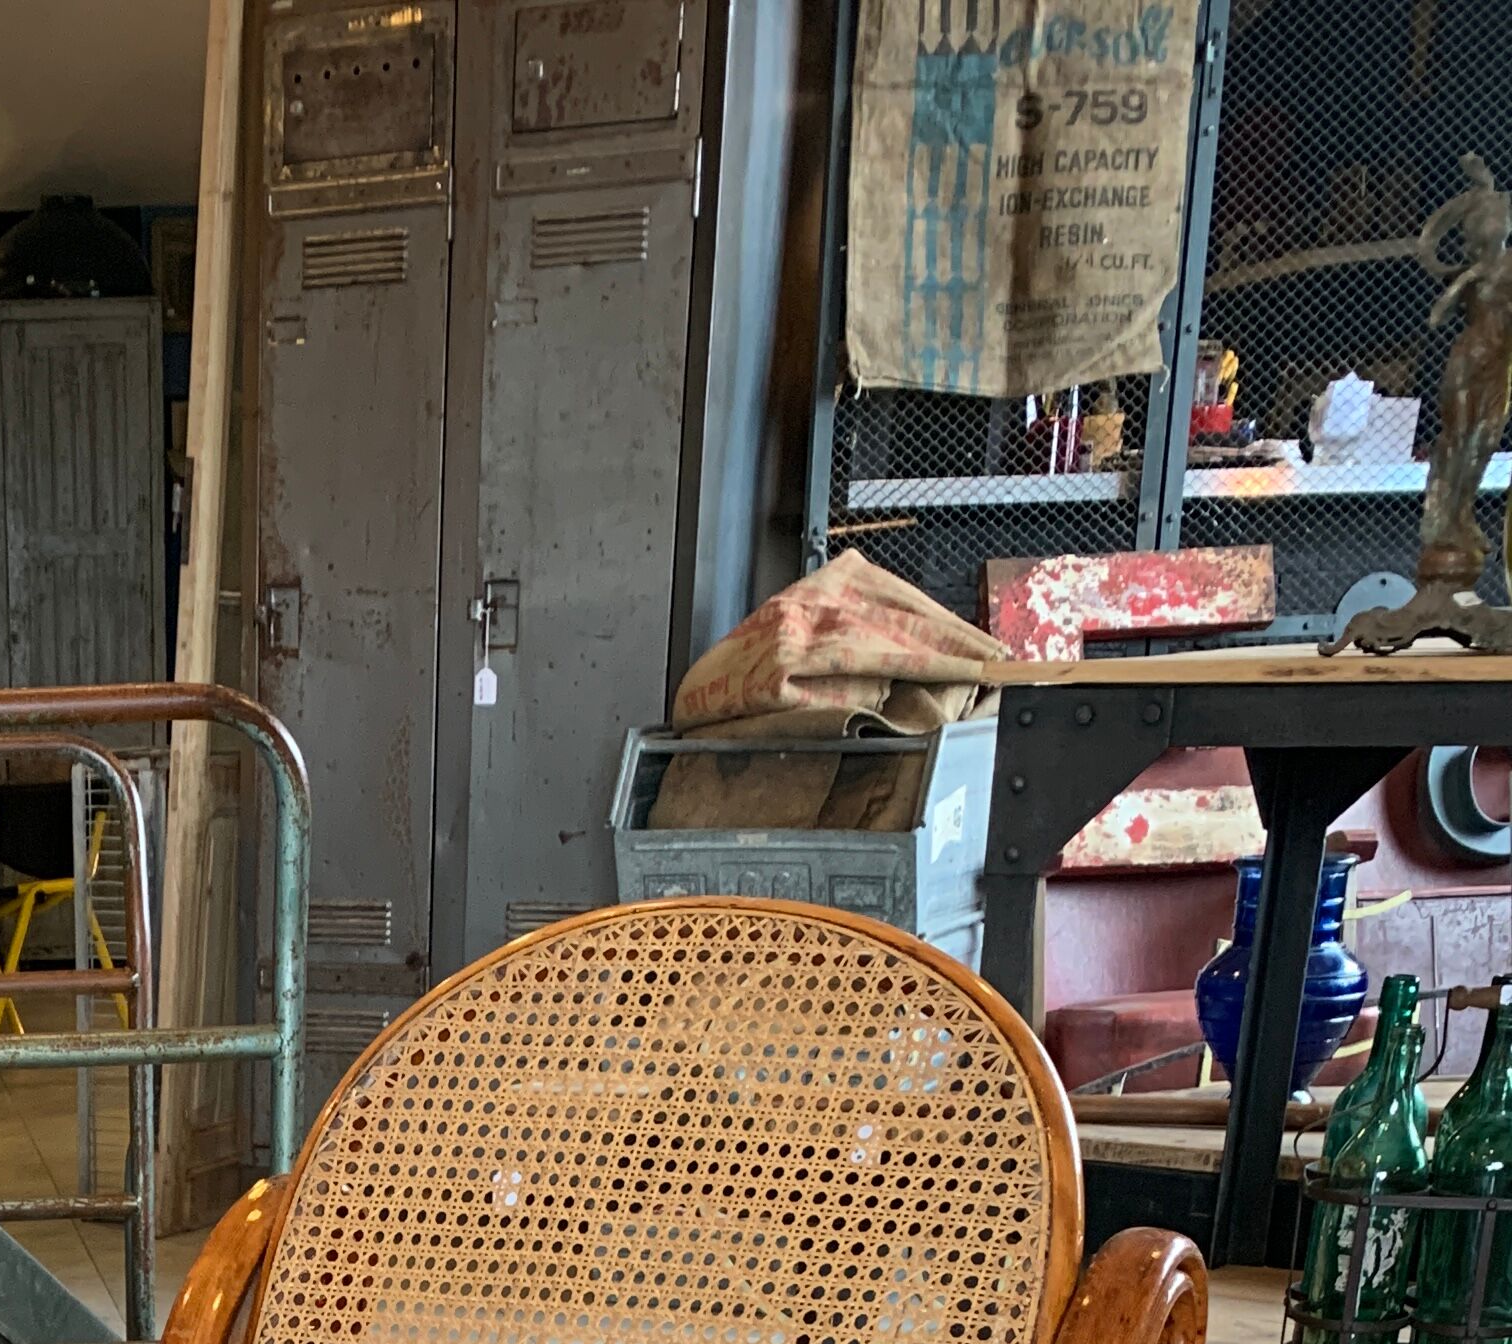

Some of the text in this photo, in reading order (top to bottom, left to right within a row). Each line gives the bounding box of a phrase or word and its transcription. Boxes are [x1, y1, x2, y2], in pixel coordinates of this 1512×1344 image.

[1014, 88, 1149, 130] S-759
[996, 145, 1159, 179] HIGH CAPACITY
[999, 185, 1151, 216] ION-EXCHANGE
